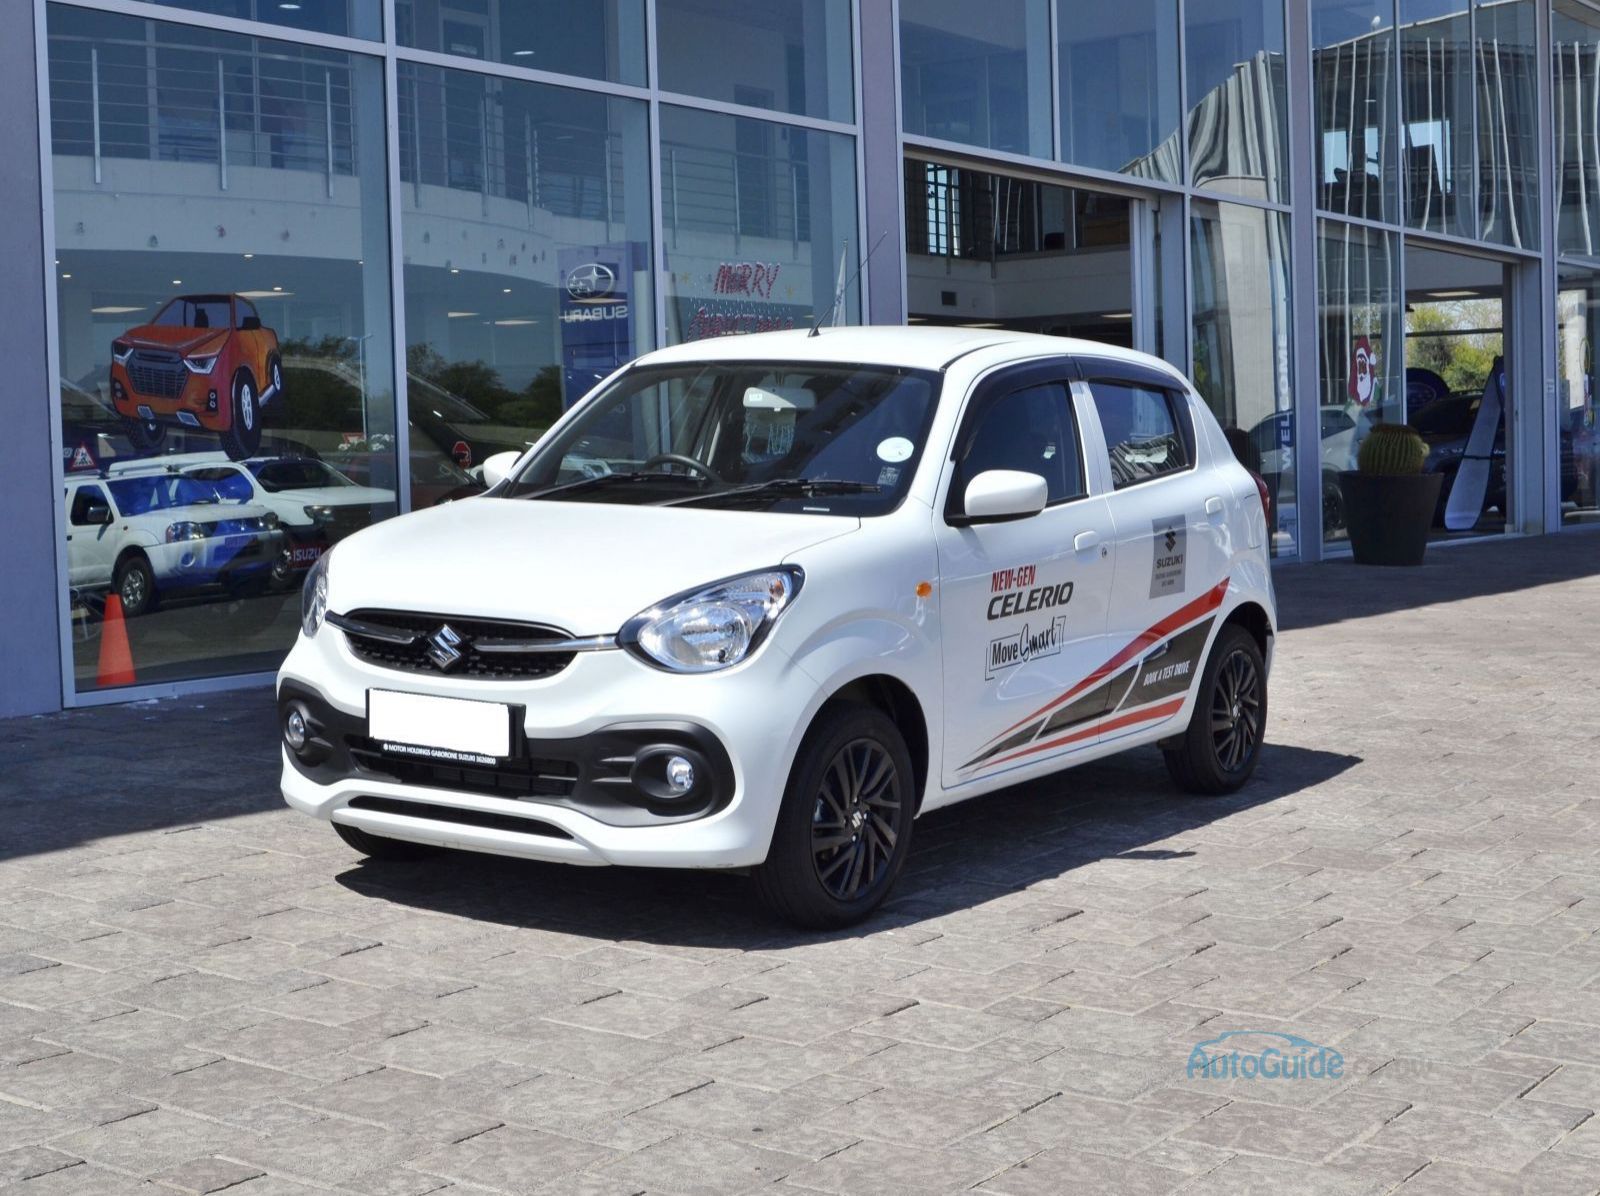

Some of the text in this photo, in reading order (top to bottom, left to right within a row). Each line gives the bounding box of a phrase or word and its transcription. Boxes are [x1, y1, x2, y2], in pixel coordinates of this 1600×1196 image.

[1156, 554, 1183, 569] SUZUKI
[991, 565, 1036, 592] NEW-GEN
[987, 581, 1074, 620] CELERIO
[992, 616, 1056, 666] Move Smart
